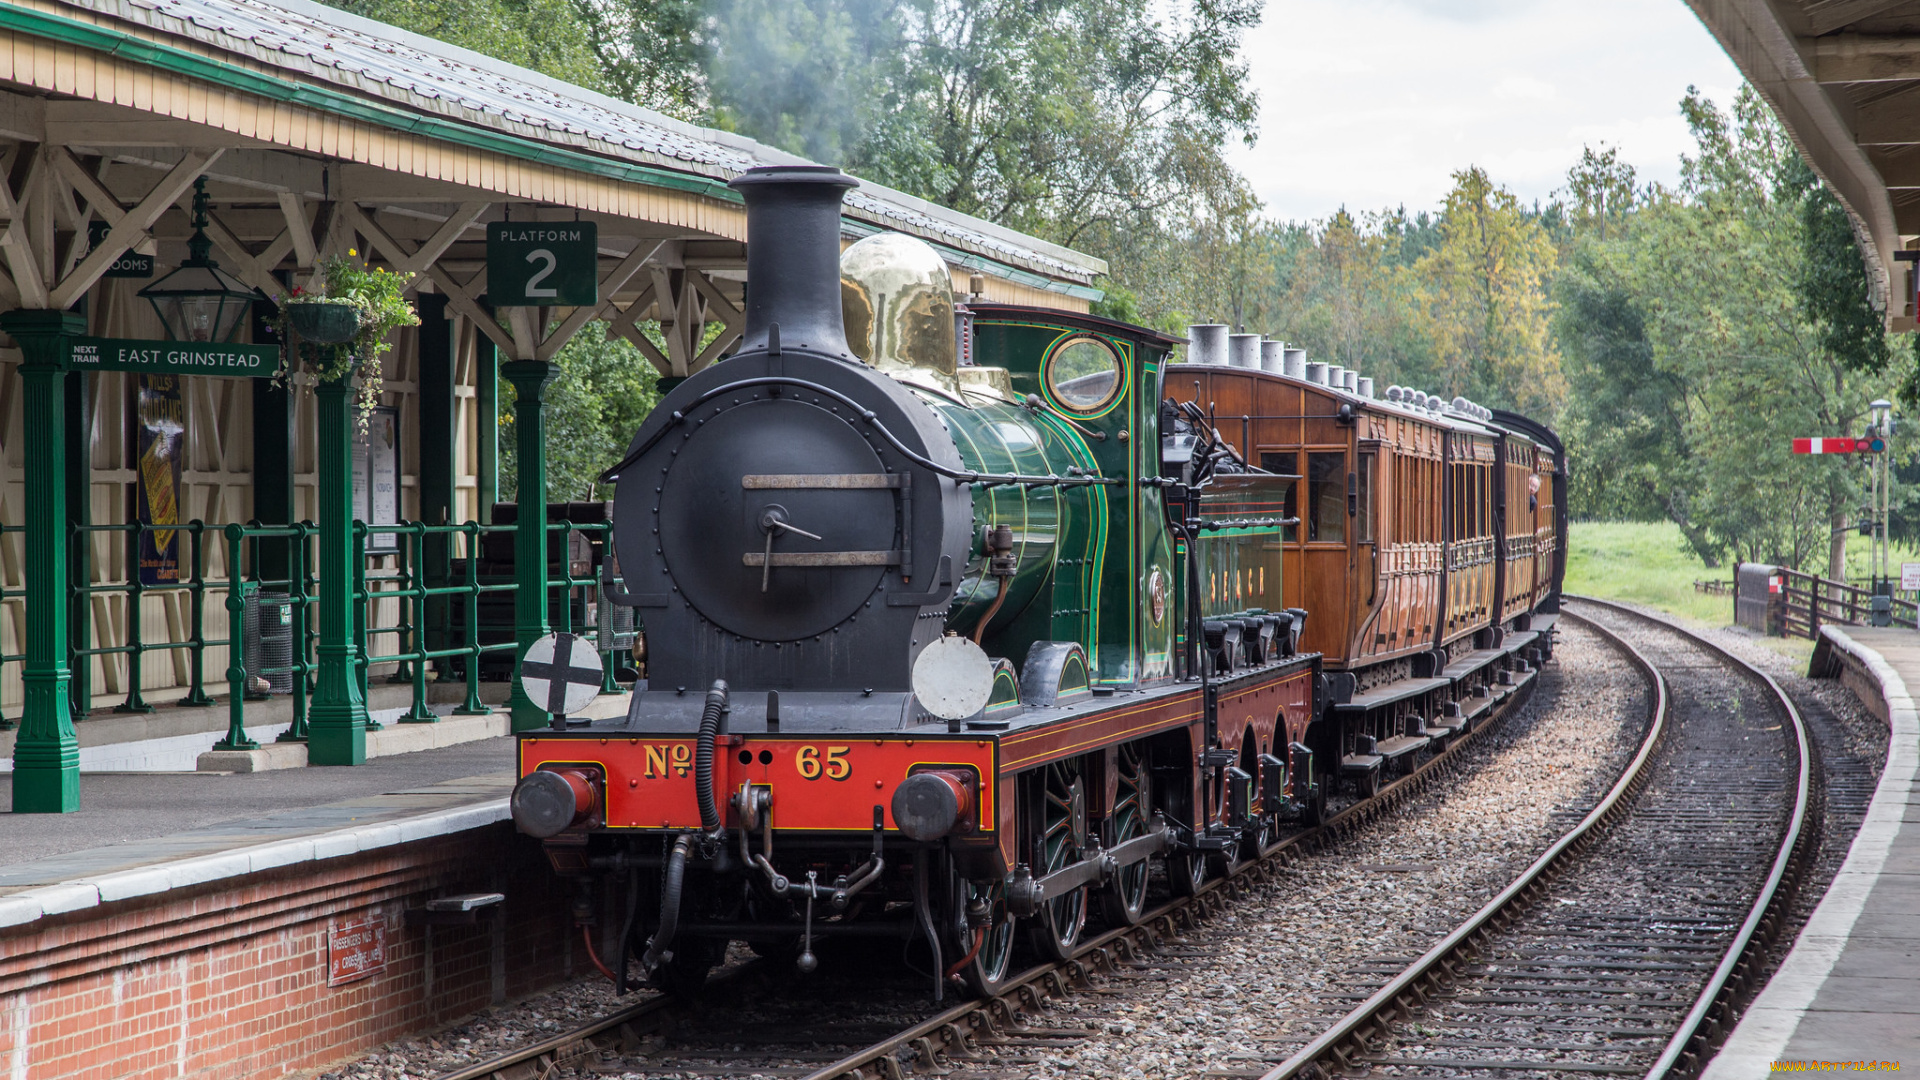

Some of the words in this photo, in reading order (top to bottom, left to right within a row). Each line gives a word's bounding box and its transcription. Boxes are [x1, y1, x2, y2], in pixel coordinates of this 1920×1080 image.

[500, 230, 581, 242] PLATFORM
[108, 260, 148, 271] OOMS
[525, 248, 557, 298] 2
[73, 345, 98, 354] NEXT
[71, 354, 100, 363] TRAIN
[118, 348, 161, 364] EAST
[167, 350, 261, 368] GRINSTEAD
[795, 745, 853, 781] 65
[333, 933, 361, 951] PASSENGERS
